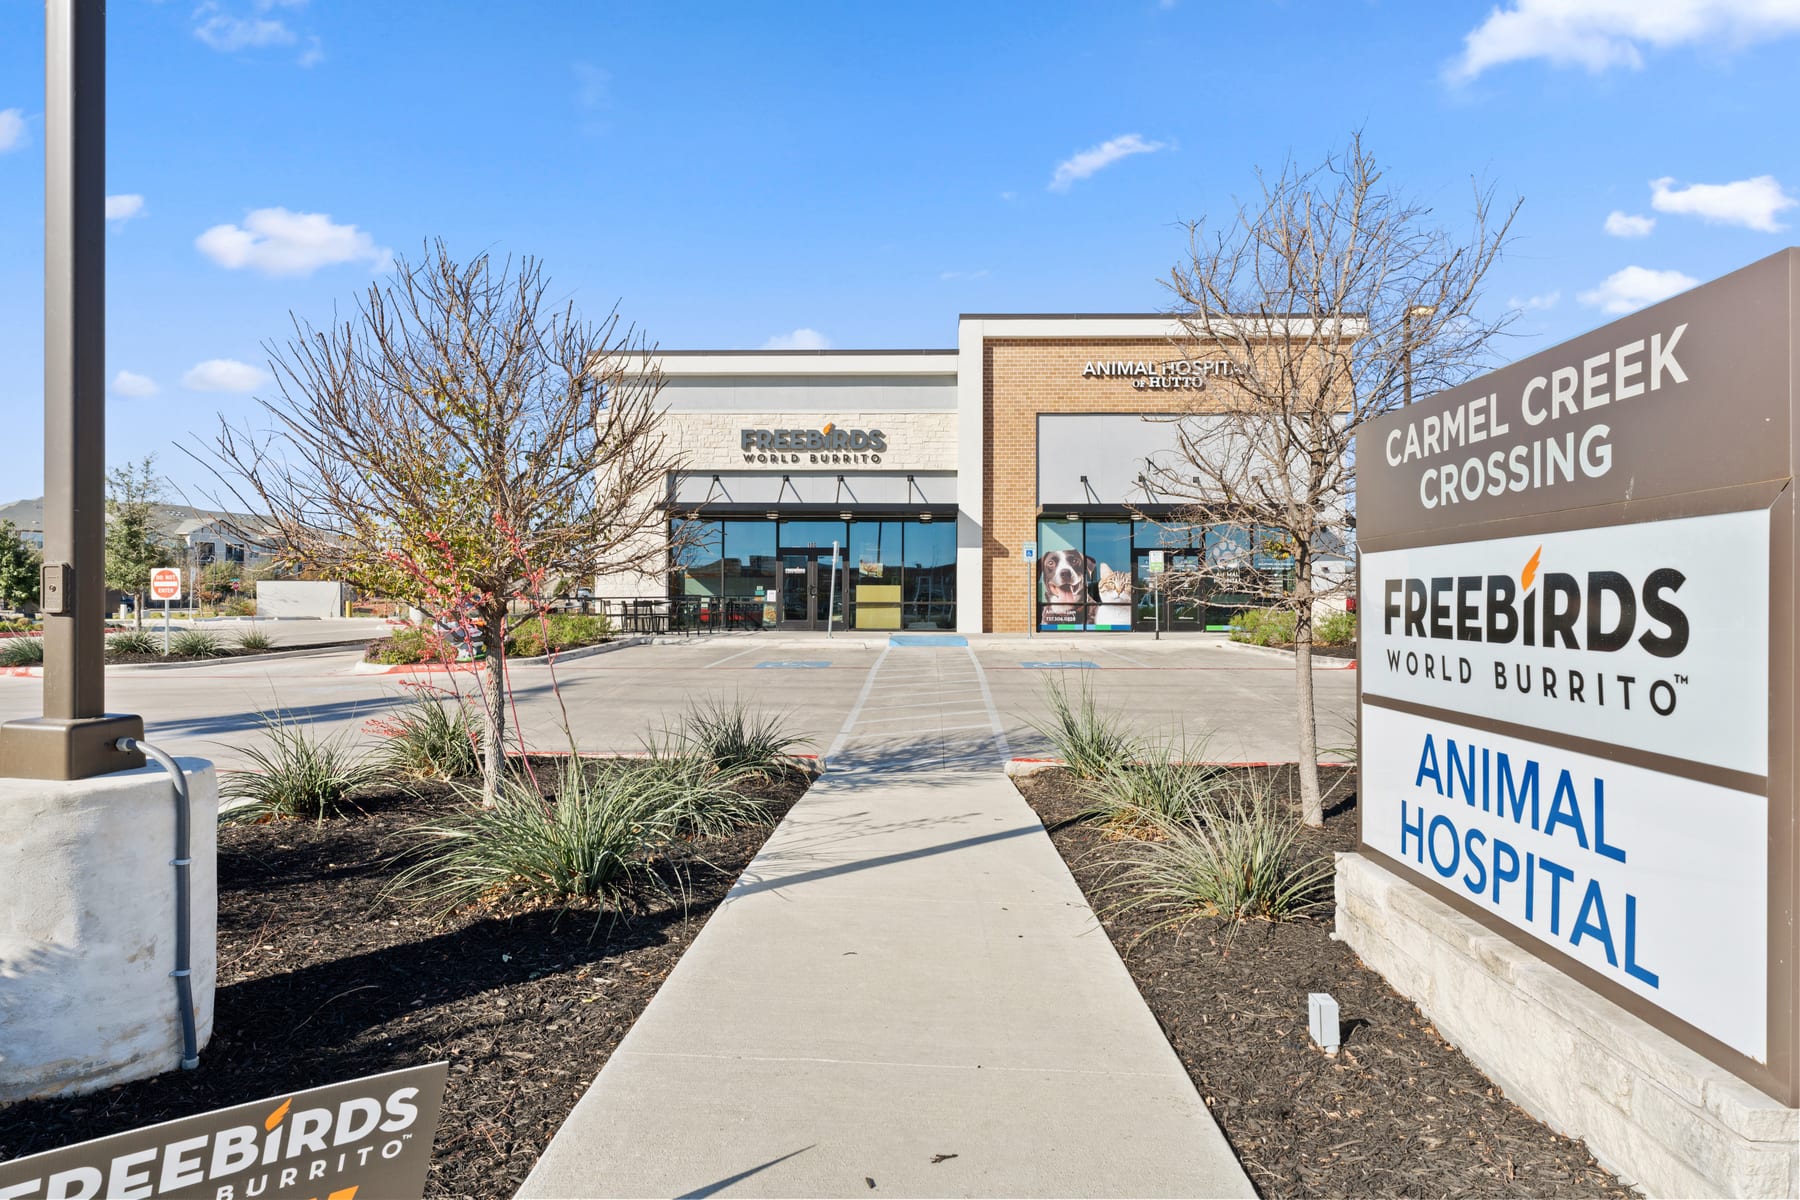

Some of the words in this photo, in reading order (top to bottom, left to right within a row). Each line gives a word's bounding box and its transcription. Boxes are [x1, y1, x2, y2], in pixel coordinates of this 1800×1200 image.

[1083, 360, 1157, 376] ANIMAL
[1132, 379, 1145, 388] OF
[1149, 376, 1203, 388] HUTTO
[1386, 393, 1509, 467] CARMEL
[1521, 323, 1689, 426] CREEK
[743, 453, 800, 464] WORLD
[810, 453, 882, 464] BURRITO
[1420, 423, 1613, 509] CROSSING
[1387, 648, 1472, 684] WORLD
[1415, 733, 1627, 865] ANIMAL
[1401, 799, 1660, 990] HOSPITAL
